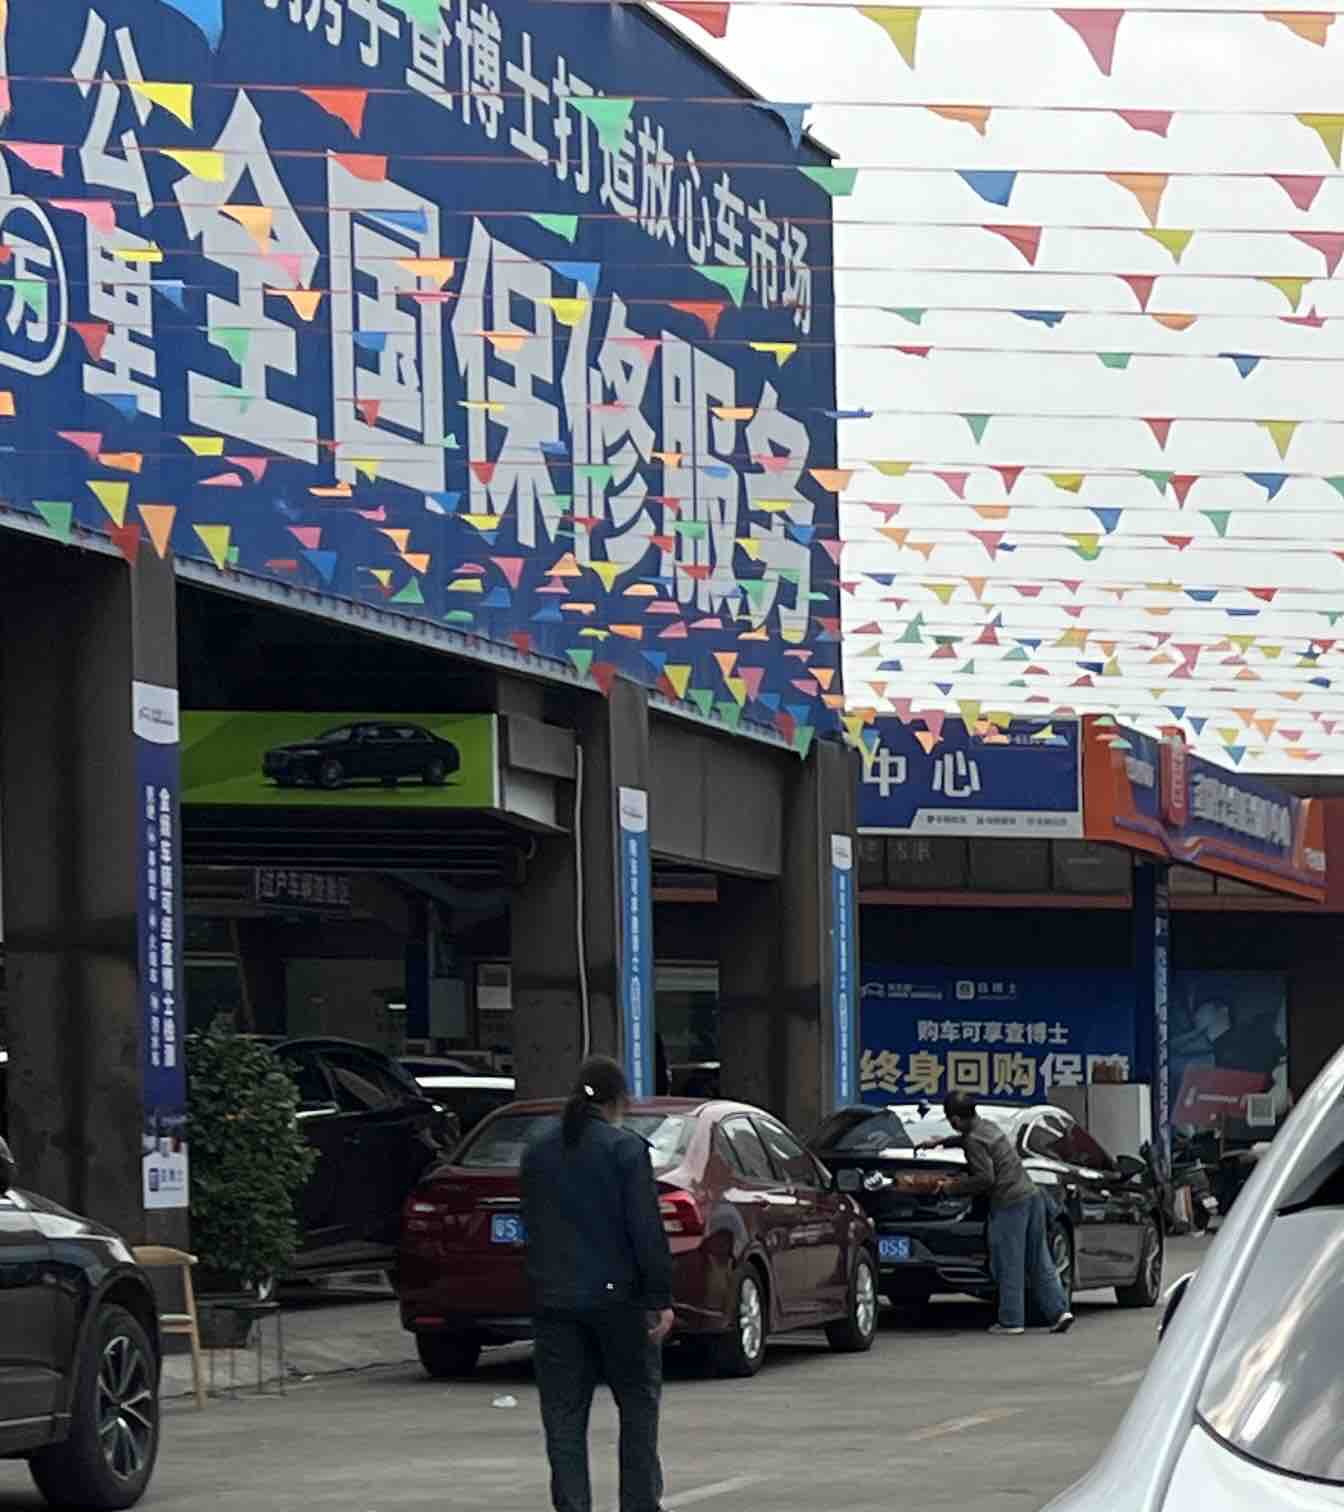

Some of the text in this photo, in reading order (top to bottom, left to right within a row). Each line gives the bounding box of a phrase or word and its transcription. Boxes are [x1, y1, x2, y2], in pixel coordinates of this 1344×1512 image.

[862, 748, 981, 799] 中心
[917, 1020, 1070, 1045] 购车可享查博士
